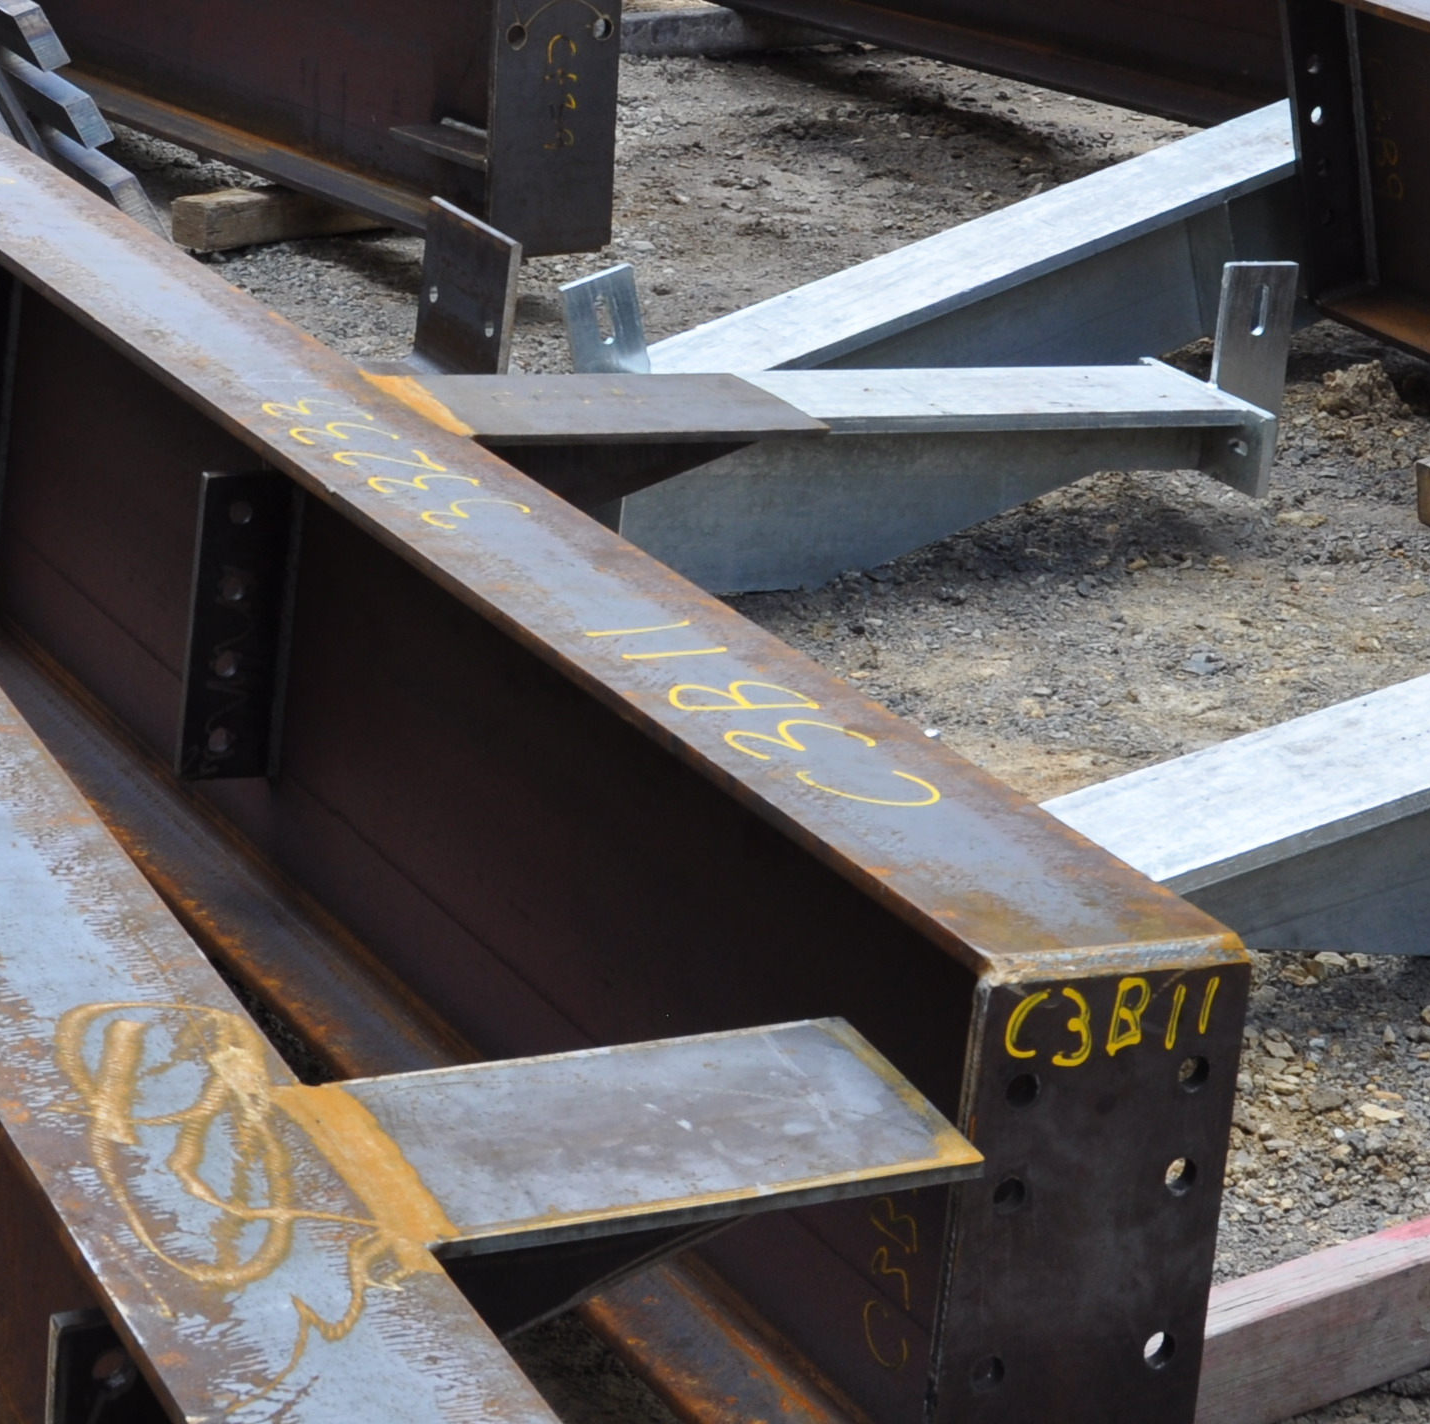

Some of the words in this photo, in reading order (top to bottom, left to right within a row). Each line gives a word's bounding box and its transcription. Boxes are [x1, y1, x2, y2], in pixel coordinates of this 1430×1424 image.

[582, 619, 941, 809] C3B11
[1003, 972, 1221, 1070] C3B11
[863, 1188, 918, 1371] C3B
